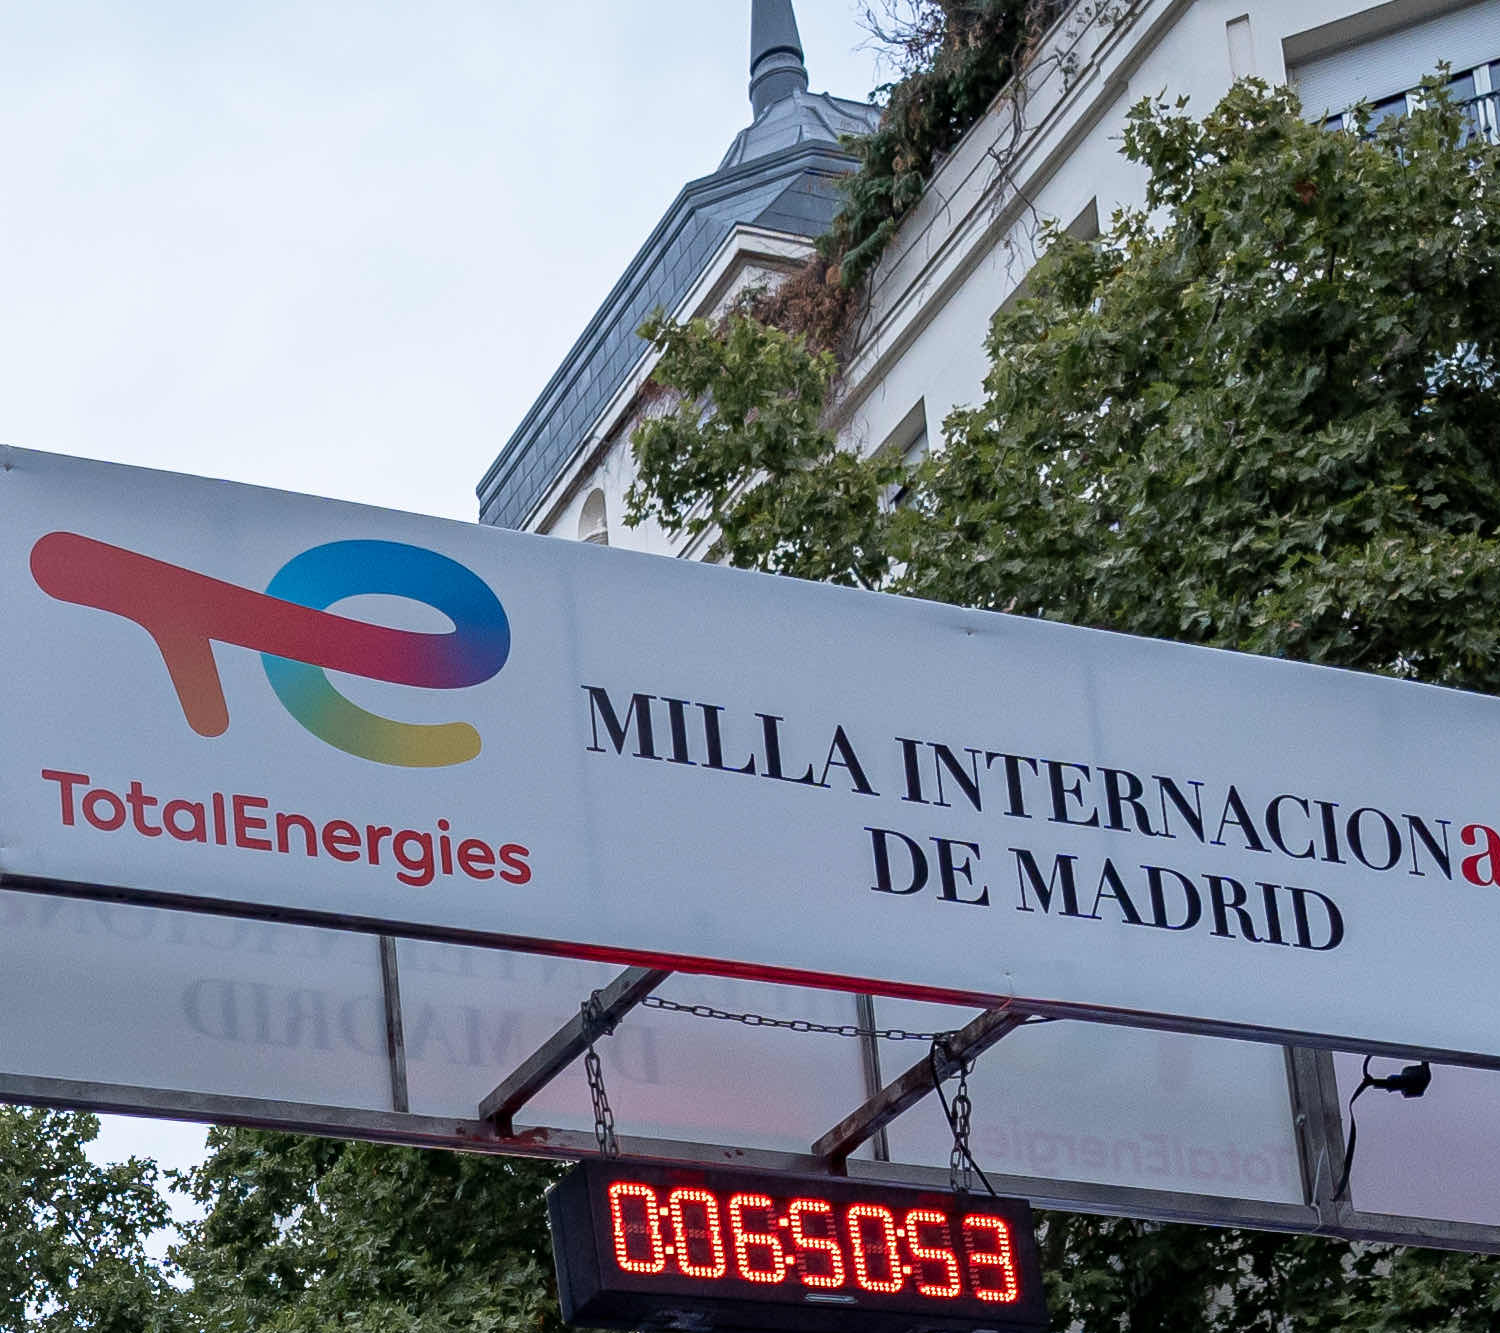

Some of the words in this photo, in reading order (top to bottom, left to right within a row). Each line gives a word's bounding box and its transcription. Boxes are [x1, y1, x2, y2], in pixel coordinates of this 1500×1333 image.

[580, 683, 881, 798] MILLA
[41, 768, 533, 888] TotalEnergies
[864, 826, 990, 907] DE
[1008, 847, 1346, 952] MADRID
